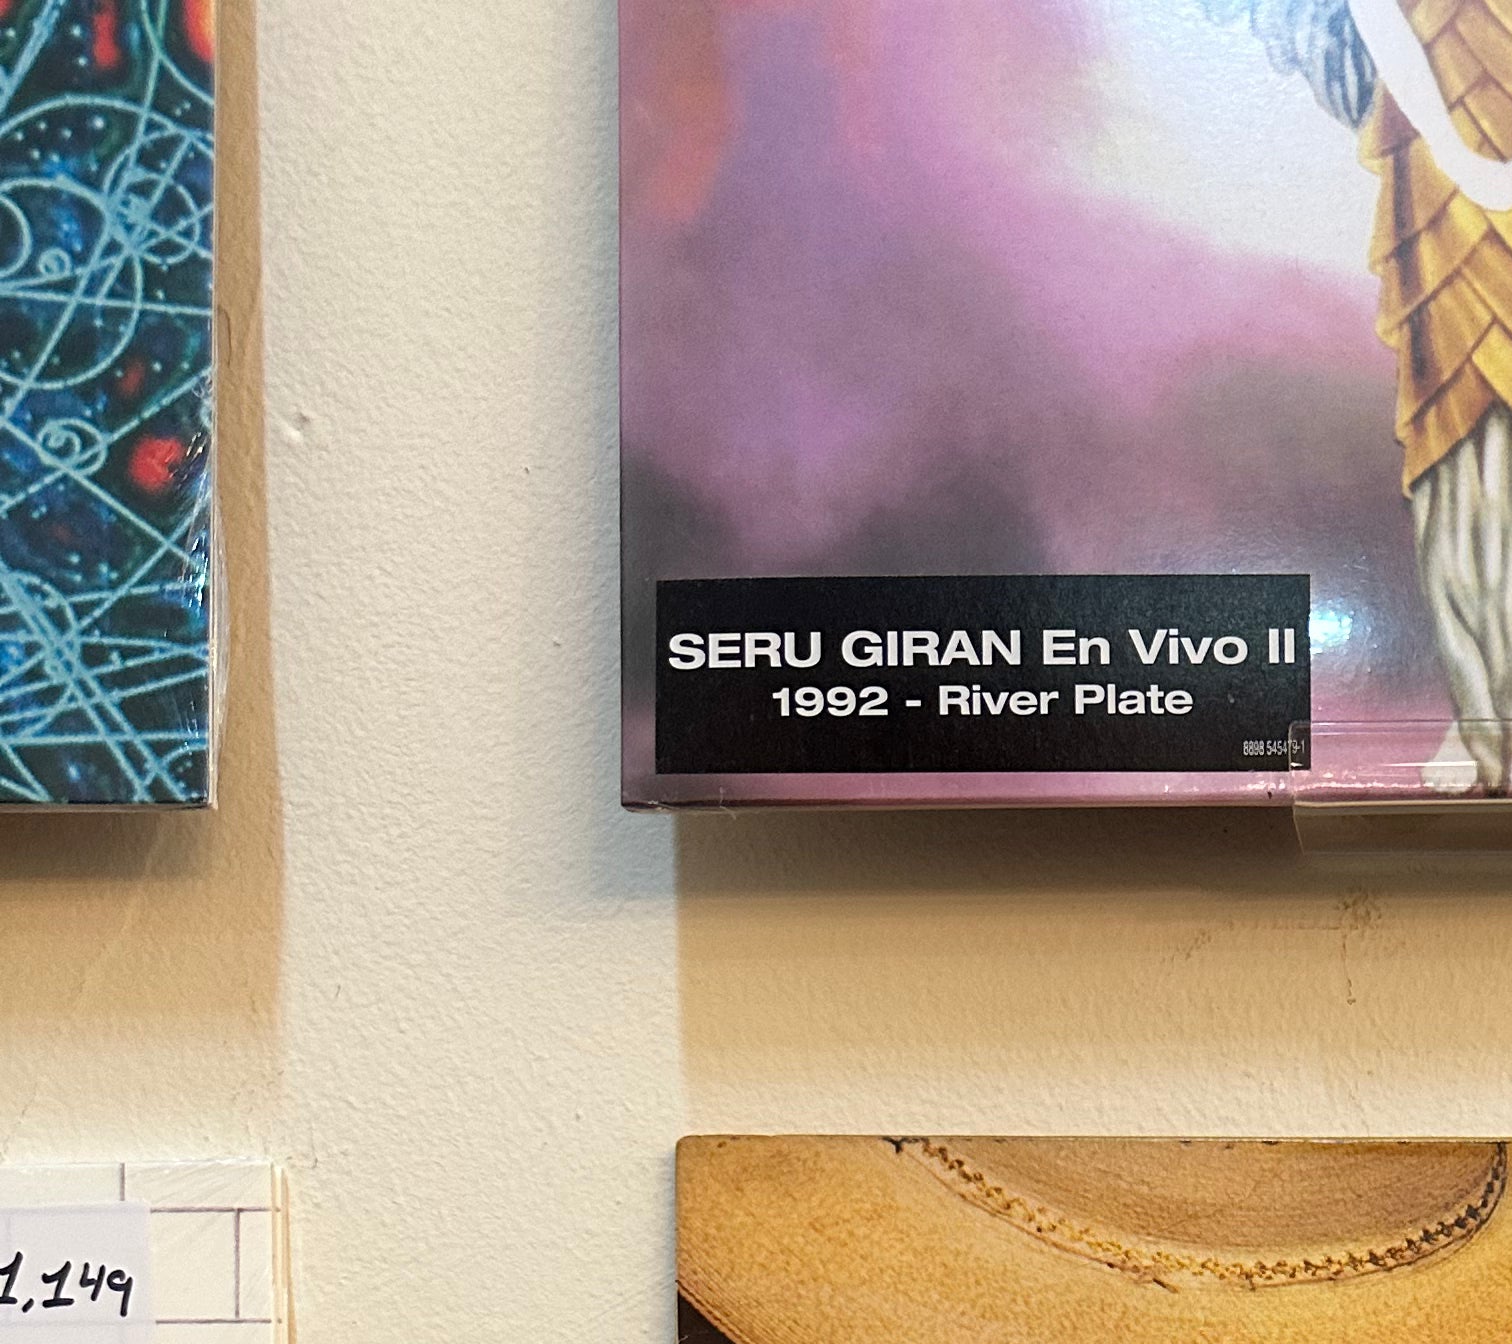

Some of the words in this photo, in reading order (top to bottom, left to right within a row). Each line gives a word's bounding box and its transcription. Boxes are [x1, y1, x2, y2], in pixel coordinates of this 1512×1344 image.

[667, 631, 822, 670] SERU
[841, 629, 1021, 668] GIRAN
[1042, 628, 1112, 667] En
[1137, 628, 1250, 666] Vivo
[1268, 628, 1296, 665] II
[772, 686, 889, 718] 1992
[938, 684, 1052, 717] River
[1074, 684, 1194, 716] Plate
